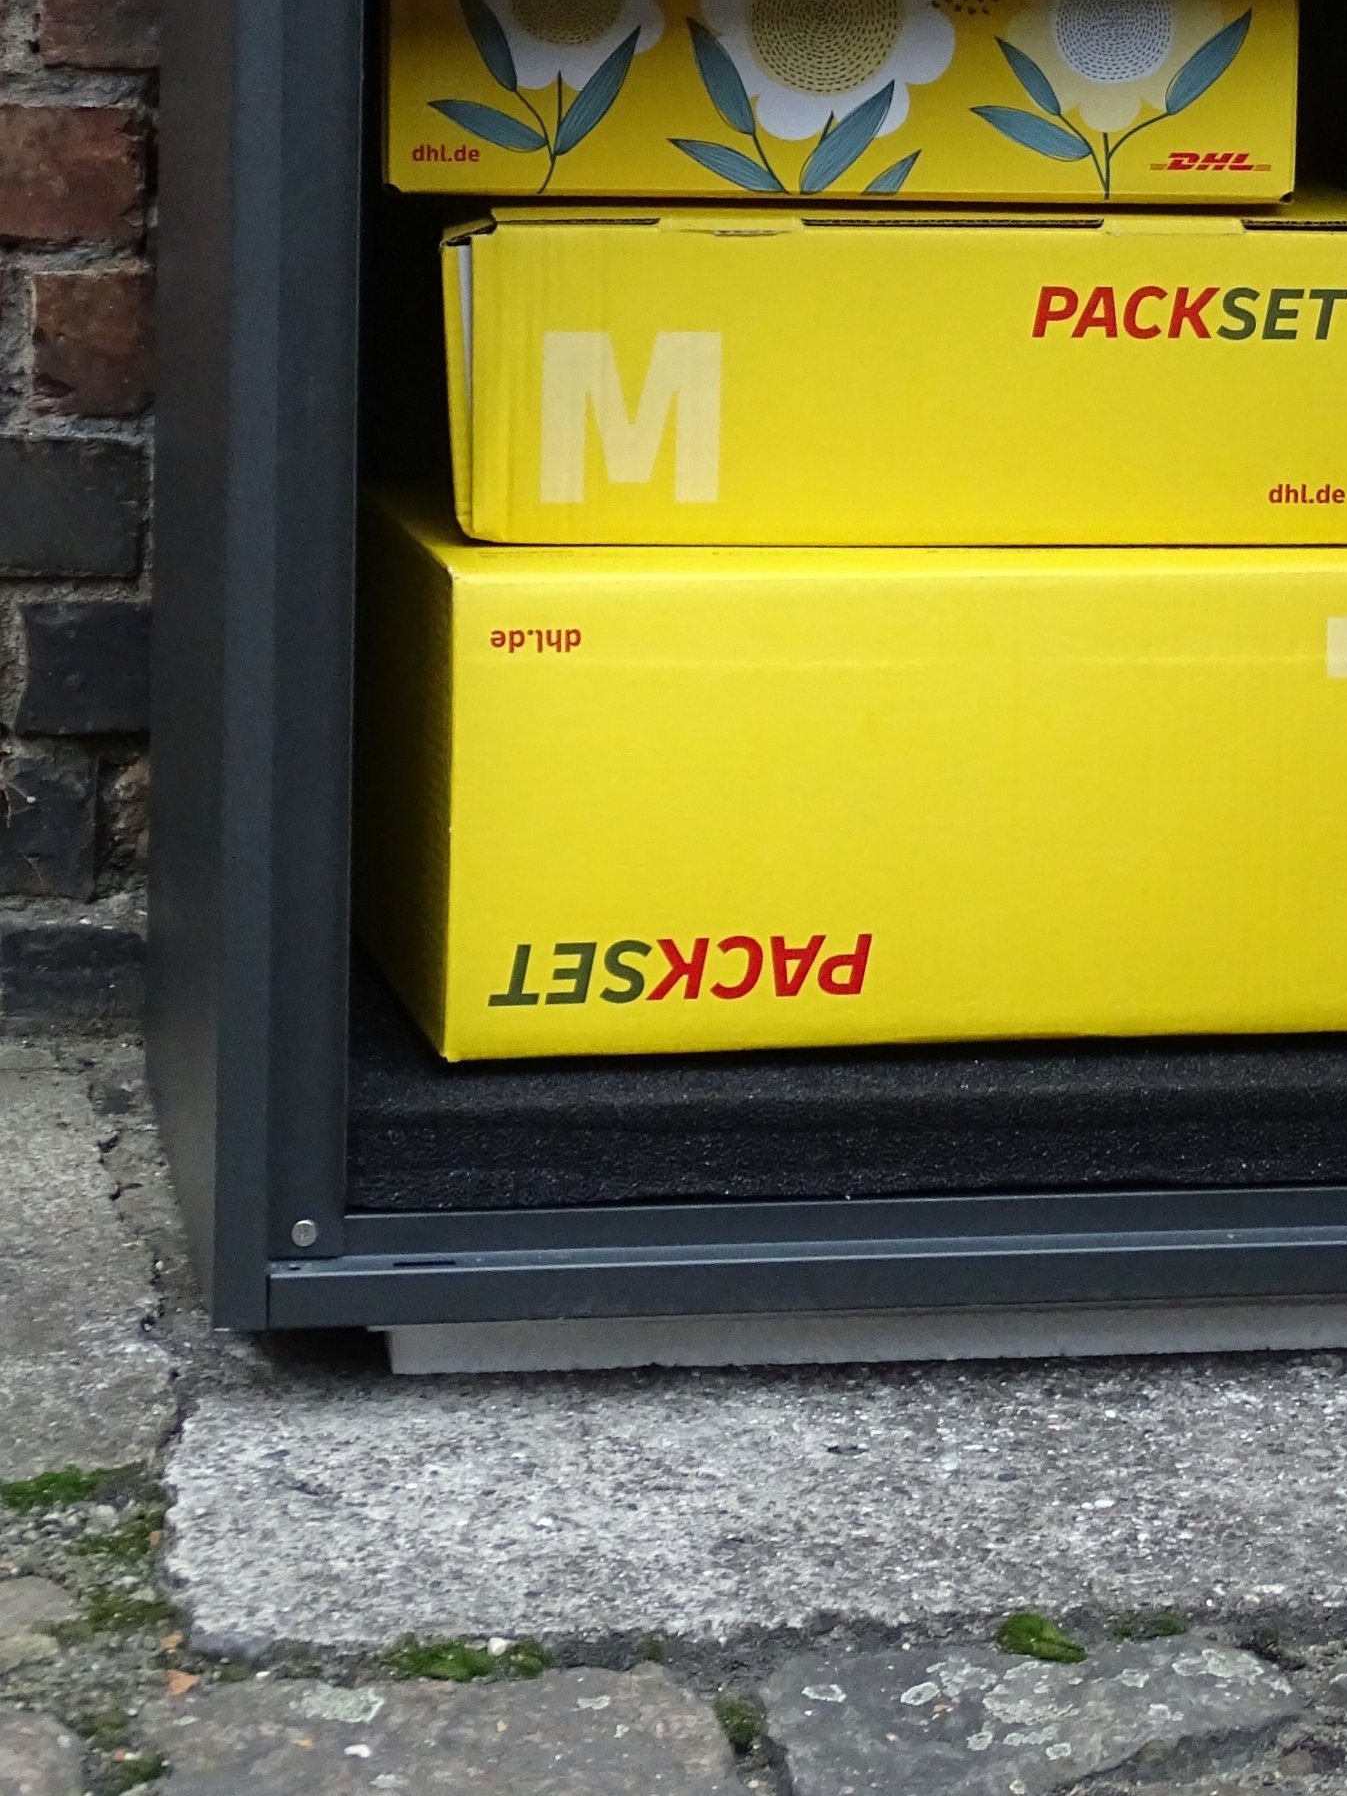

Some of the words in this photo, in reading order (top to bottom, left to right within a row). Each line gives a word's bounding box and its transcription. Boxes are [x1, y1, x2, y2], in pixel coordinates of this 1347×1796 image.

[412, 143, 480, 163] dhl.de
[1166, 152, 1256, 172] DHL
[538, 329, 723, 505] M
[1267, 483, 1346, 505] dhl.de
[490, 629, 582, 652] dhl.de
[487, 933, 873, 1006] PACKSET
